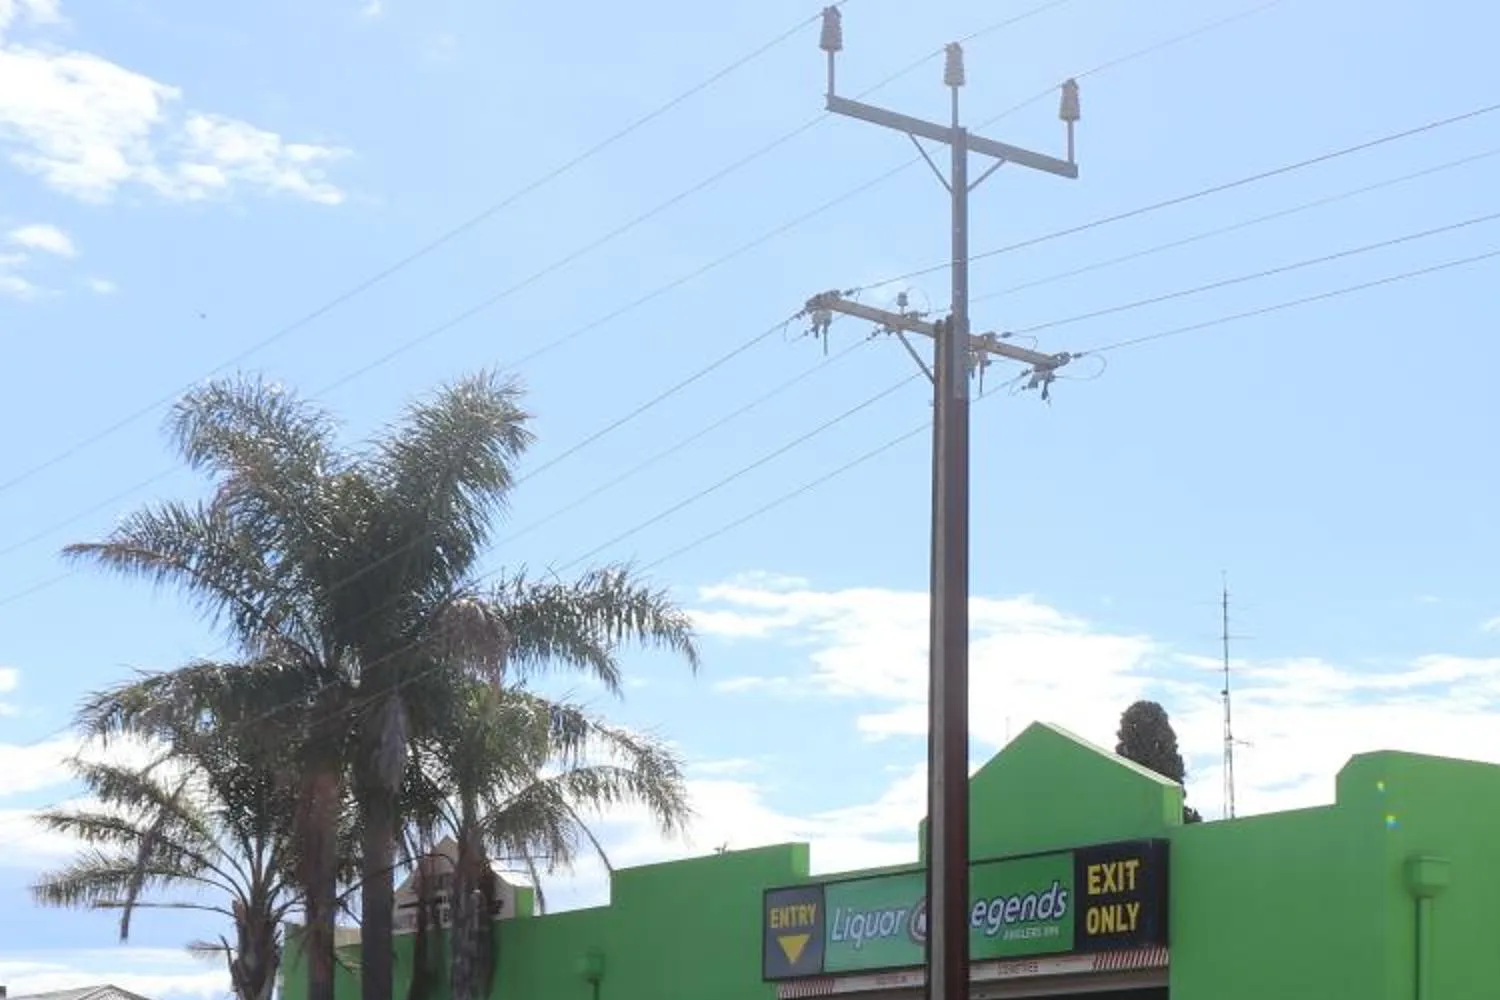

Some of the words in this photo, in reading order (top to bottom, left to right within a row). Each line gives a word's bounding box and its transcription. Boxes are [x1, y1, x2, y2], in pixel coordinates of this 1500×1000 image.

[1087, 859, 1140, 895] EXIT
[770, 904, 817, 929] ENTRY
[970, 880, 1069, 936] egends
[1086, 902, 1140, 935] ONLY
[831, 907, 906, 949] Liquor
